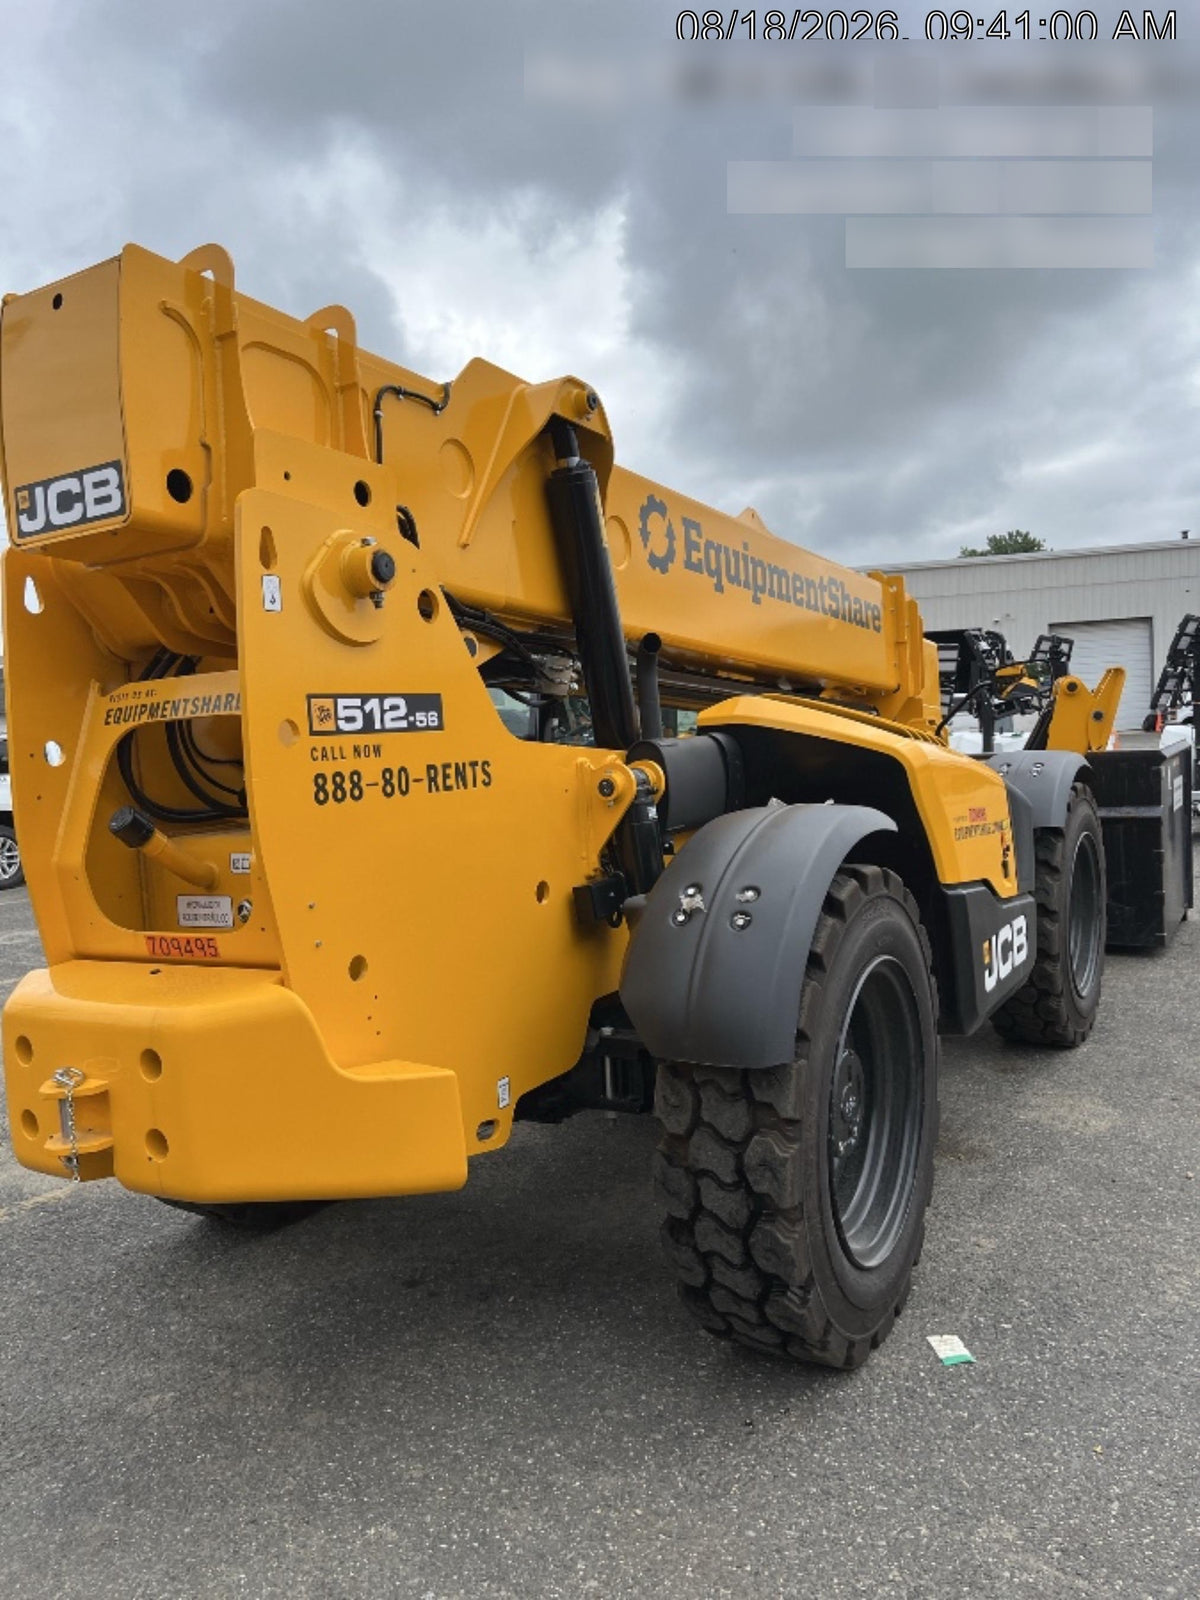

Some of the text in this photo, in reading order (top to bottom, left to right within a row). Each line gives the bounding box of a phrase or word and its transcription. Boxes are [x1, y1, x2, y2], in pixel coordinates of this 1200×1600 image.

[19, 466, 122, 533] JCB
[682, 517, 882, 634] EquipmentShare
[336, 696, 439, 731] 512-56
[310, 744, 383, 762] CALL NOW
[313, 760, 492, 806] 888-80-RENTS
[147, 936, 218, 958] 709495
[983, 914, 1028, 993] JCB
